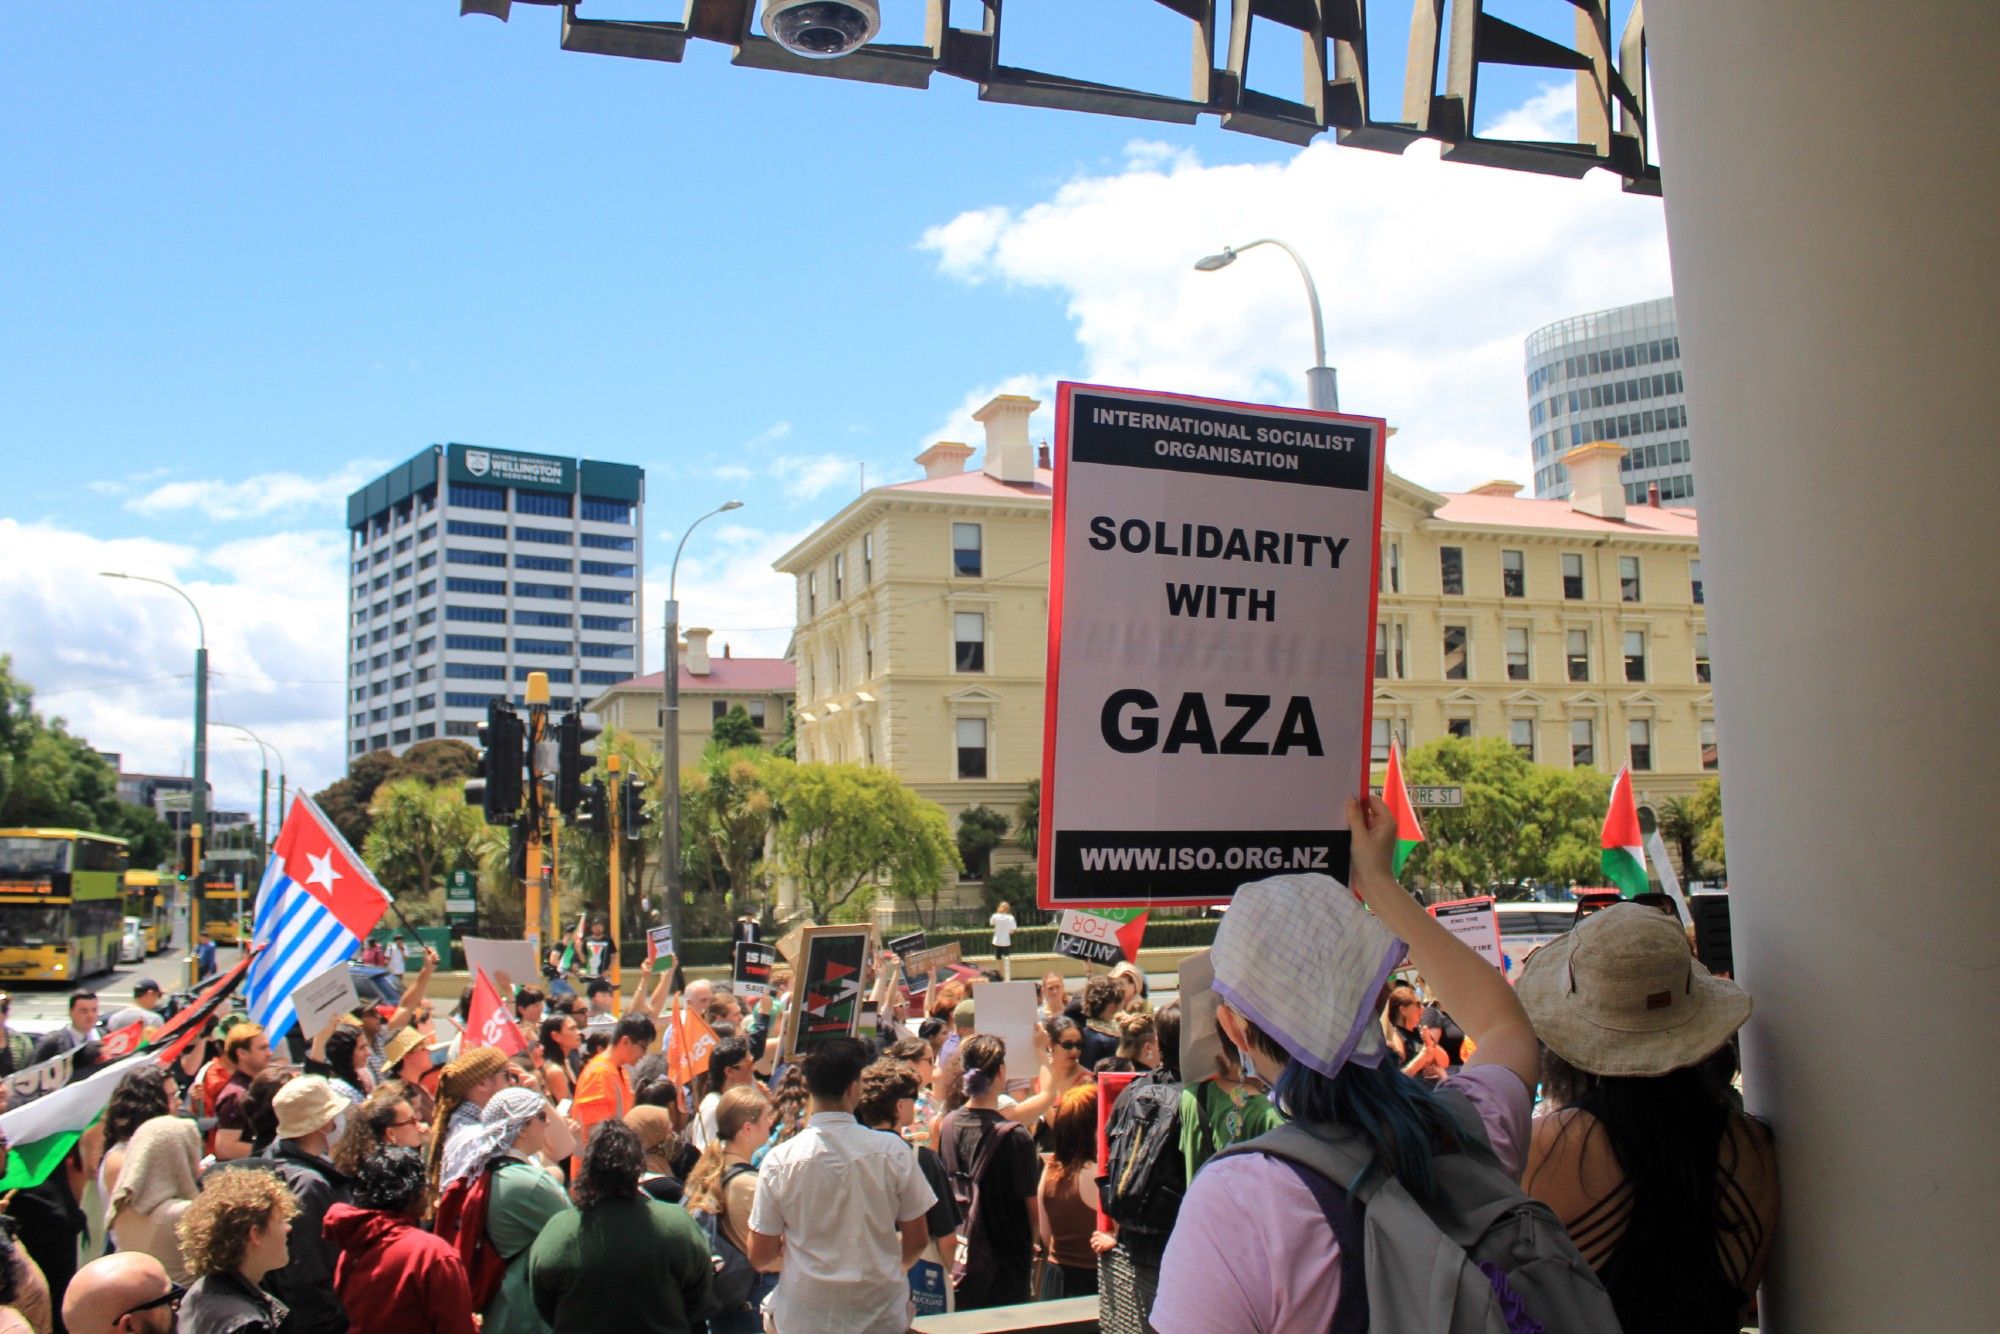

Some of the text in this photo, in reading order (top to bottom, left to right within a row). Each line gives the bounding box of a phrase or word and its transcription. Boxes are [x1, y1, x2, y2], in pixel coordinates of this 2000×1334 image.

[1093, 408, 1355, 453] INTERNATIONAL SOCIALIST
[1154, 440, 1299, 470] ORGANISATION
[491, 460, 562, 477] WELLINGTON
[1088, 516, 1350, 569] SOLIDARITY
[1165, 582, 1276, 622] WITH
[1100, 688, 1325, 757] GAZA
[1440, 789, 1453, 802] ST
[1080, 846, 1329, 871] WWW.ISO.ORG.NZ
[1072, 915, 1108, 938] FOR
[1061, 935, 1118, 961] ANTIFA
[745, 984, 765, 994] SAVE
